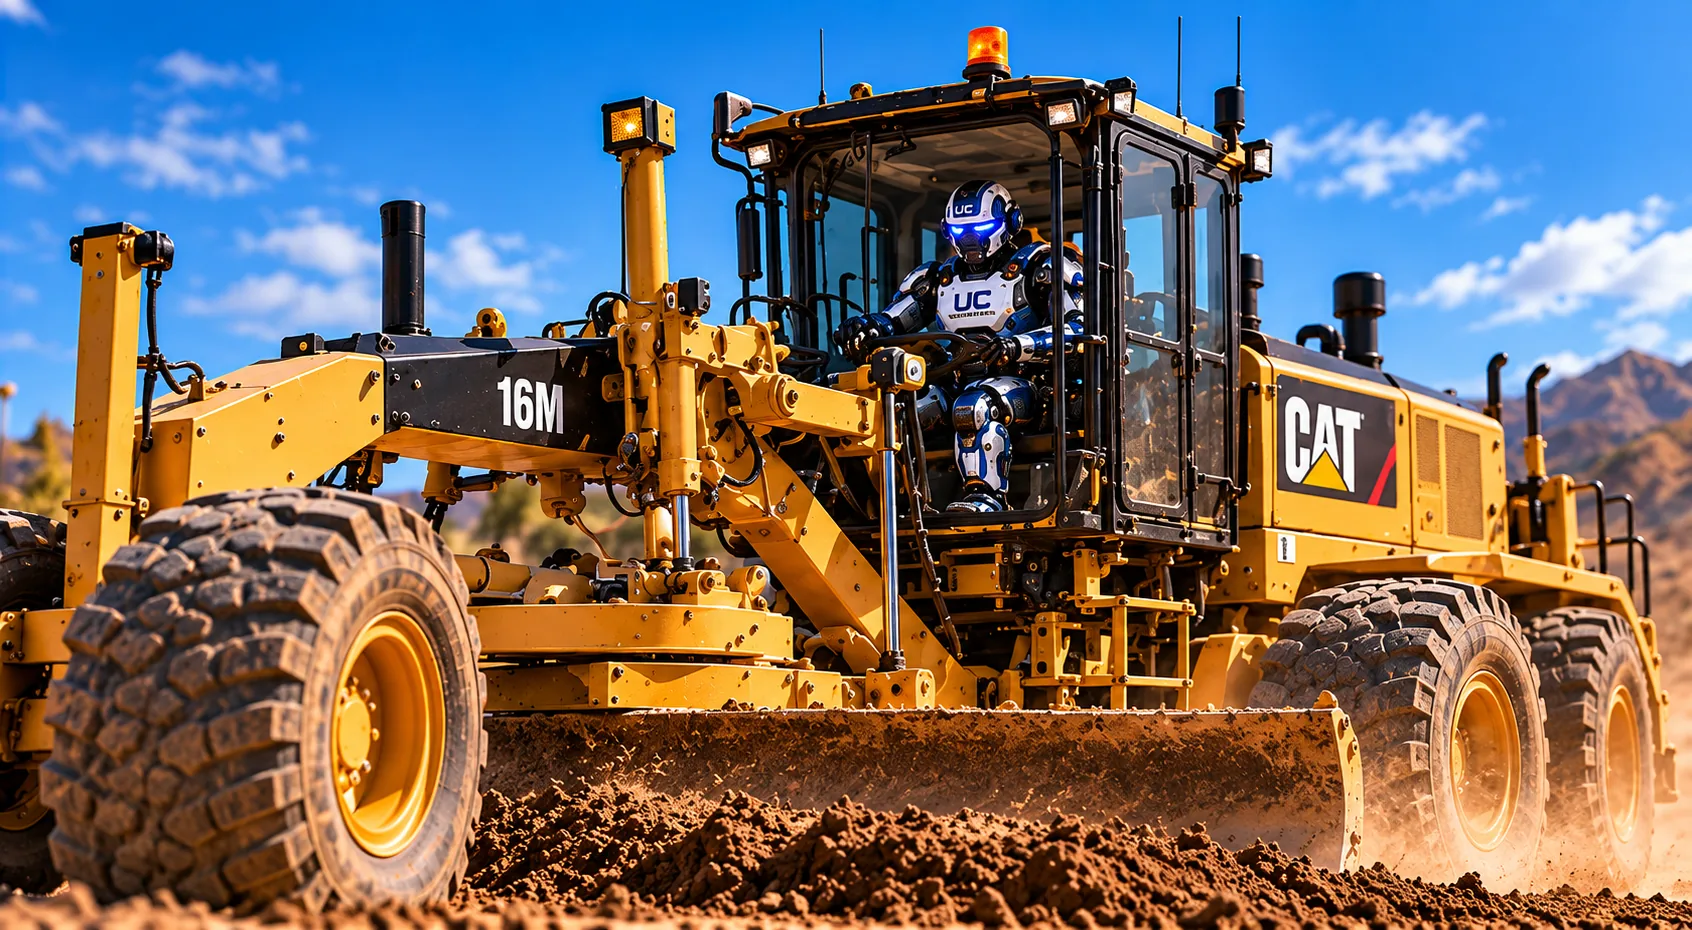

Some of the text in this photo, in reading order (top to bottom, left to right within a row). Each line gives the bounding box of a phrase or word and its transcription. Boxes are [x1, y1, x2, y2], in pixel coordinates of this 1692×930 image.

[955, 204, 974, 215] UC
[954, 290, 992, 312] UC
[497, 375, 564, 434] 16M
[1284, 395, 1361, 493] CAT
